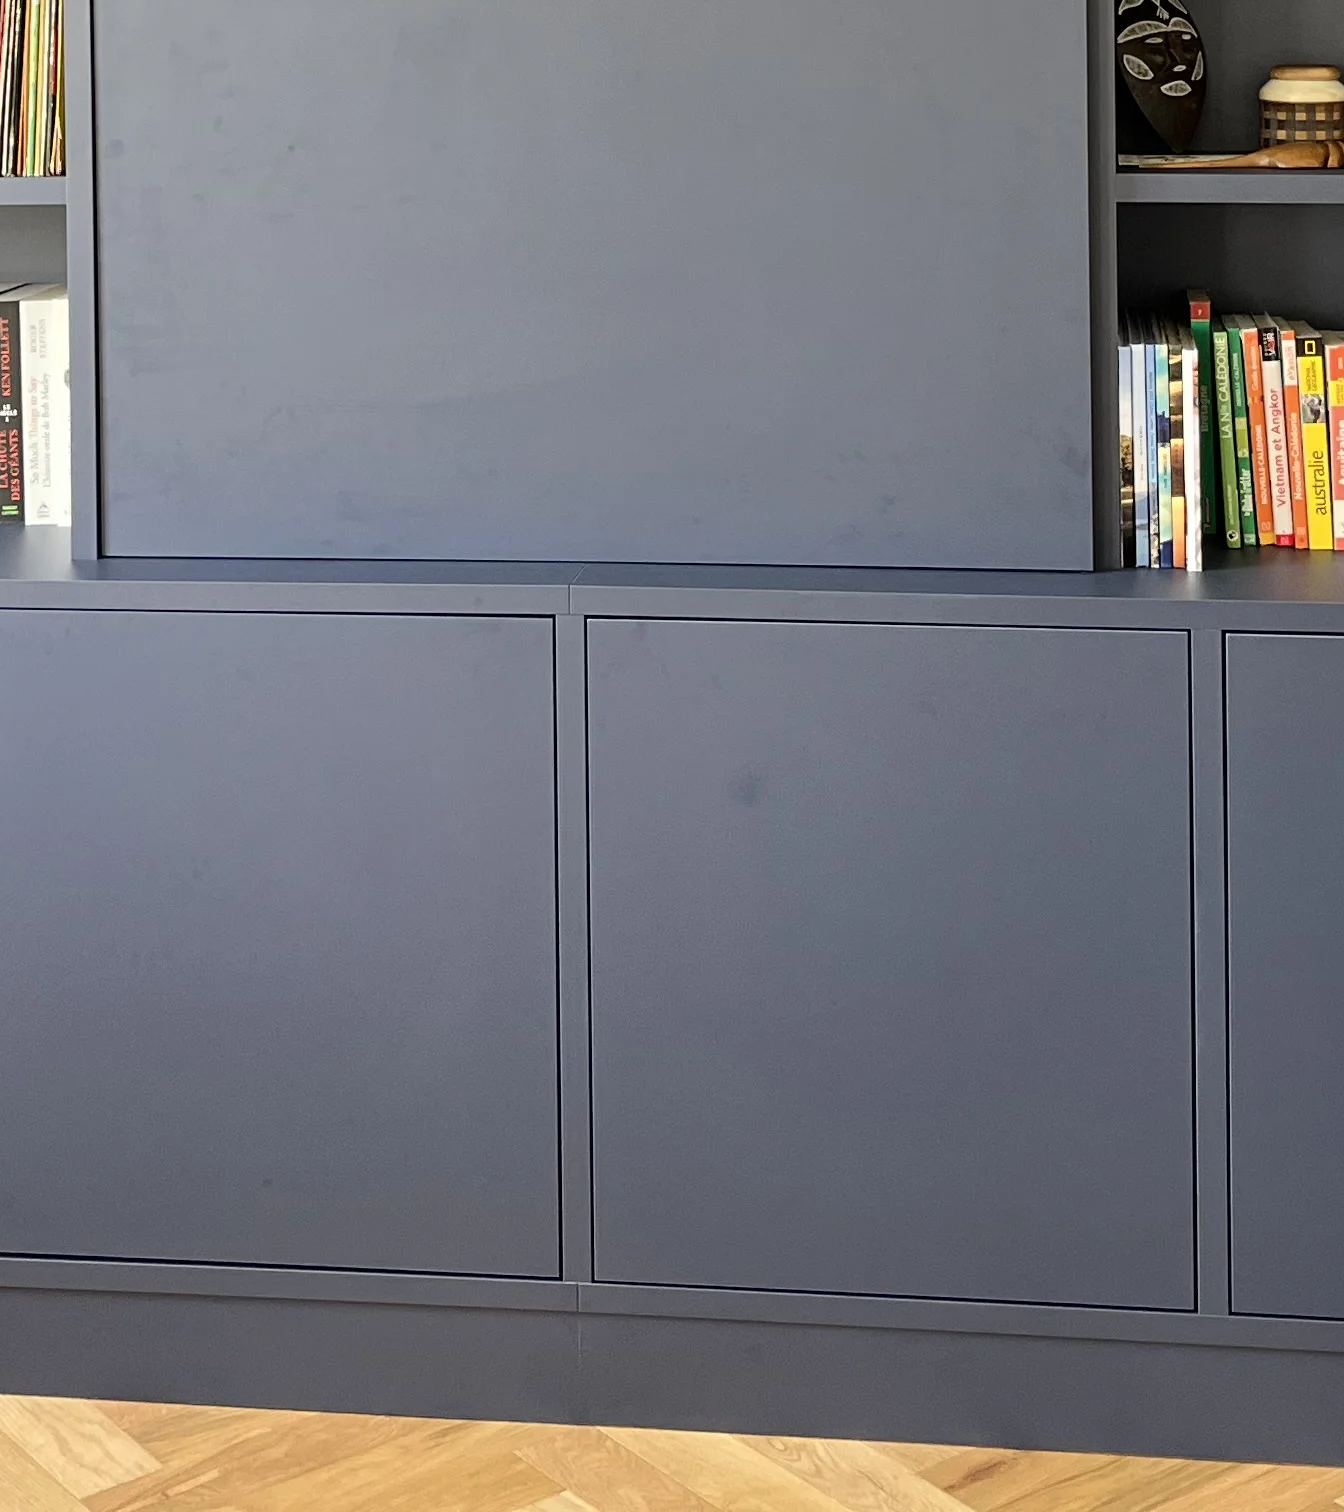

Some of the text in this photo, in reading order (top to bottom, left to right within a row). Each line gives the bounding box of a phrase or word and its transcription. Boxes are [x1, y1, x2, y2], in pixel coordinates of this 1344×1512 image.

[0, 317, 12, 397] KEN FOLLETT
[1215, 337, 1232, 439] LA CALÉDONIE
[0, 473, 9, 489] LA
[8, 429, 21, 501] DES GÉANTS
[1269, 388, 1287, 508] Vietnam et Angkor
[1309, 450, 1328, 516] australie
